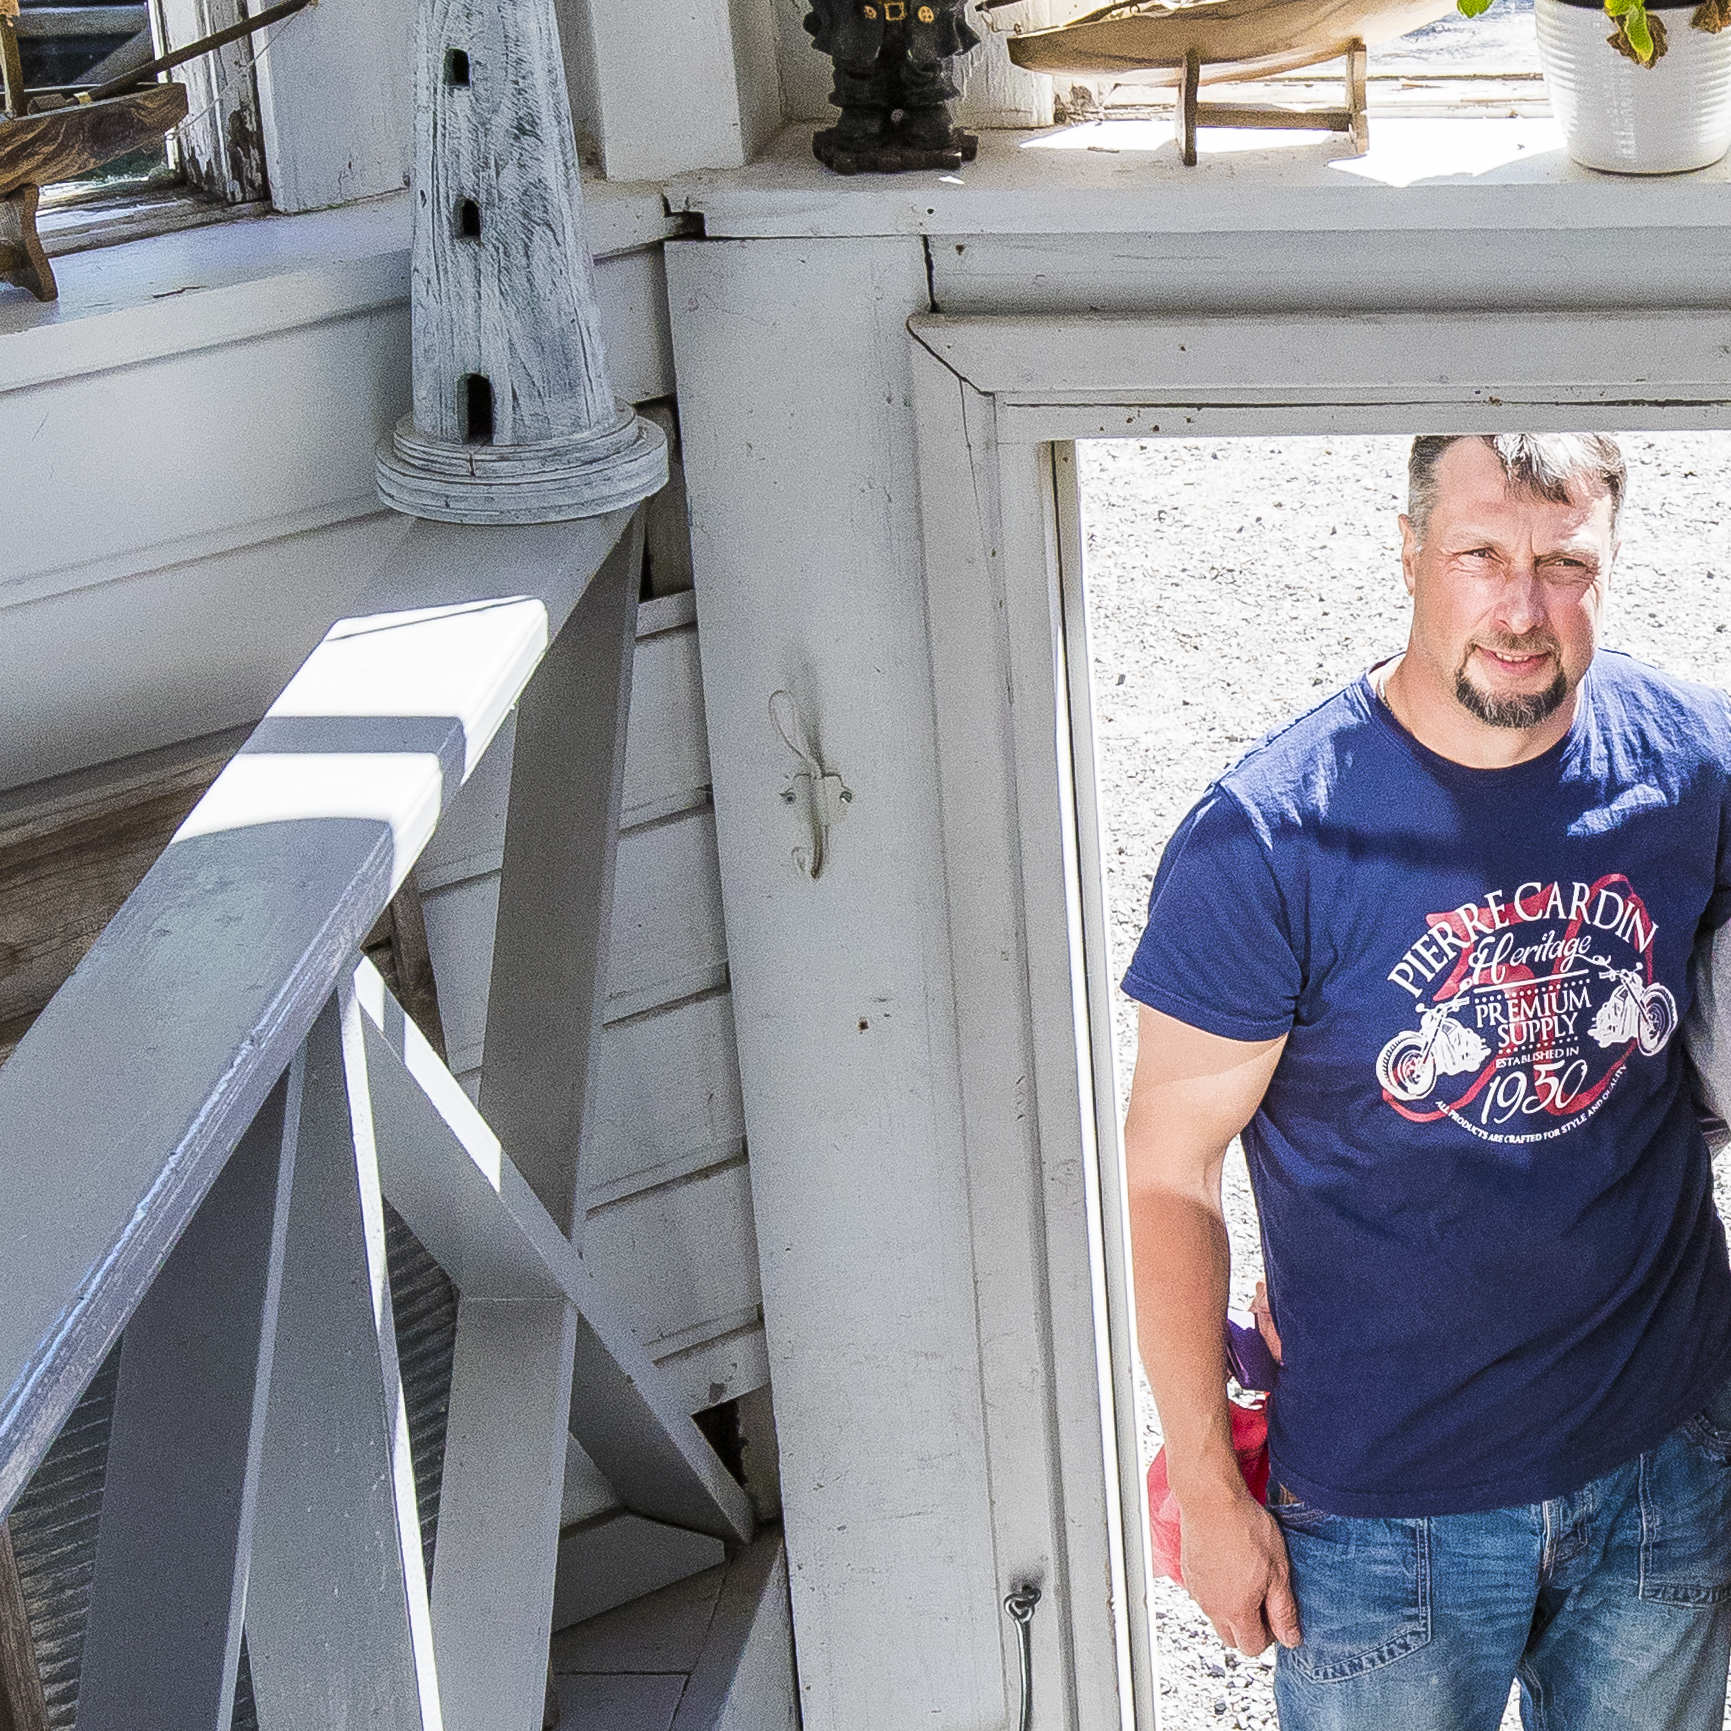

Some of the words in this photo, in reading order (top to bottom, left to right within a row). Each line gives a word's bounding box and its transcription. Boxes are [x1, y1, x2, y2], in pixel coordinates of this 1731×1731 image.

[1387, 889, 1511, 998] PIERRE
[1513, 880, 1659, 954] CARDIN
[1468, 929, 1592, 986] Heritage
[1476, 985, 1592, 1029] PREMIUM
[1497, 1012, 1579, 1048] SUPPLY
[1495, 1048, 1565, 1069] ESTABLISHED
[1566, 1045, 1580, 1057] IN
[1435, 1100, 1450, 1114] ALL
[1448, 1109, 1488, 1140] PRODUCTS
[1488, 1133, 1504, 1143] ARE
[1504, 1133, 1542, 1144] CRAFTED
[1543, 1128, 1561, 1139] FOR
[1560, 1113, 1588, 1134] STYLE
[1587, 1098, 1604, 1117] AND
[1602, 1065, 1627, 1101] QUALITY
[1481, 1058, 1588, 1125] 1950
